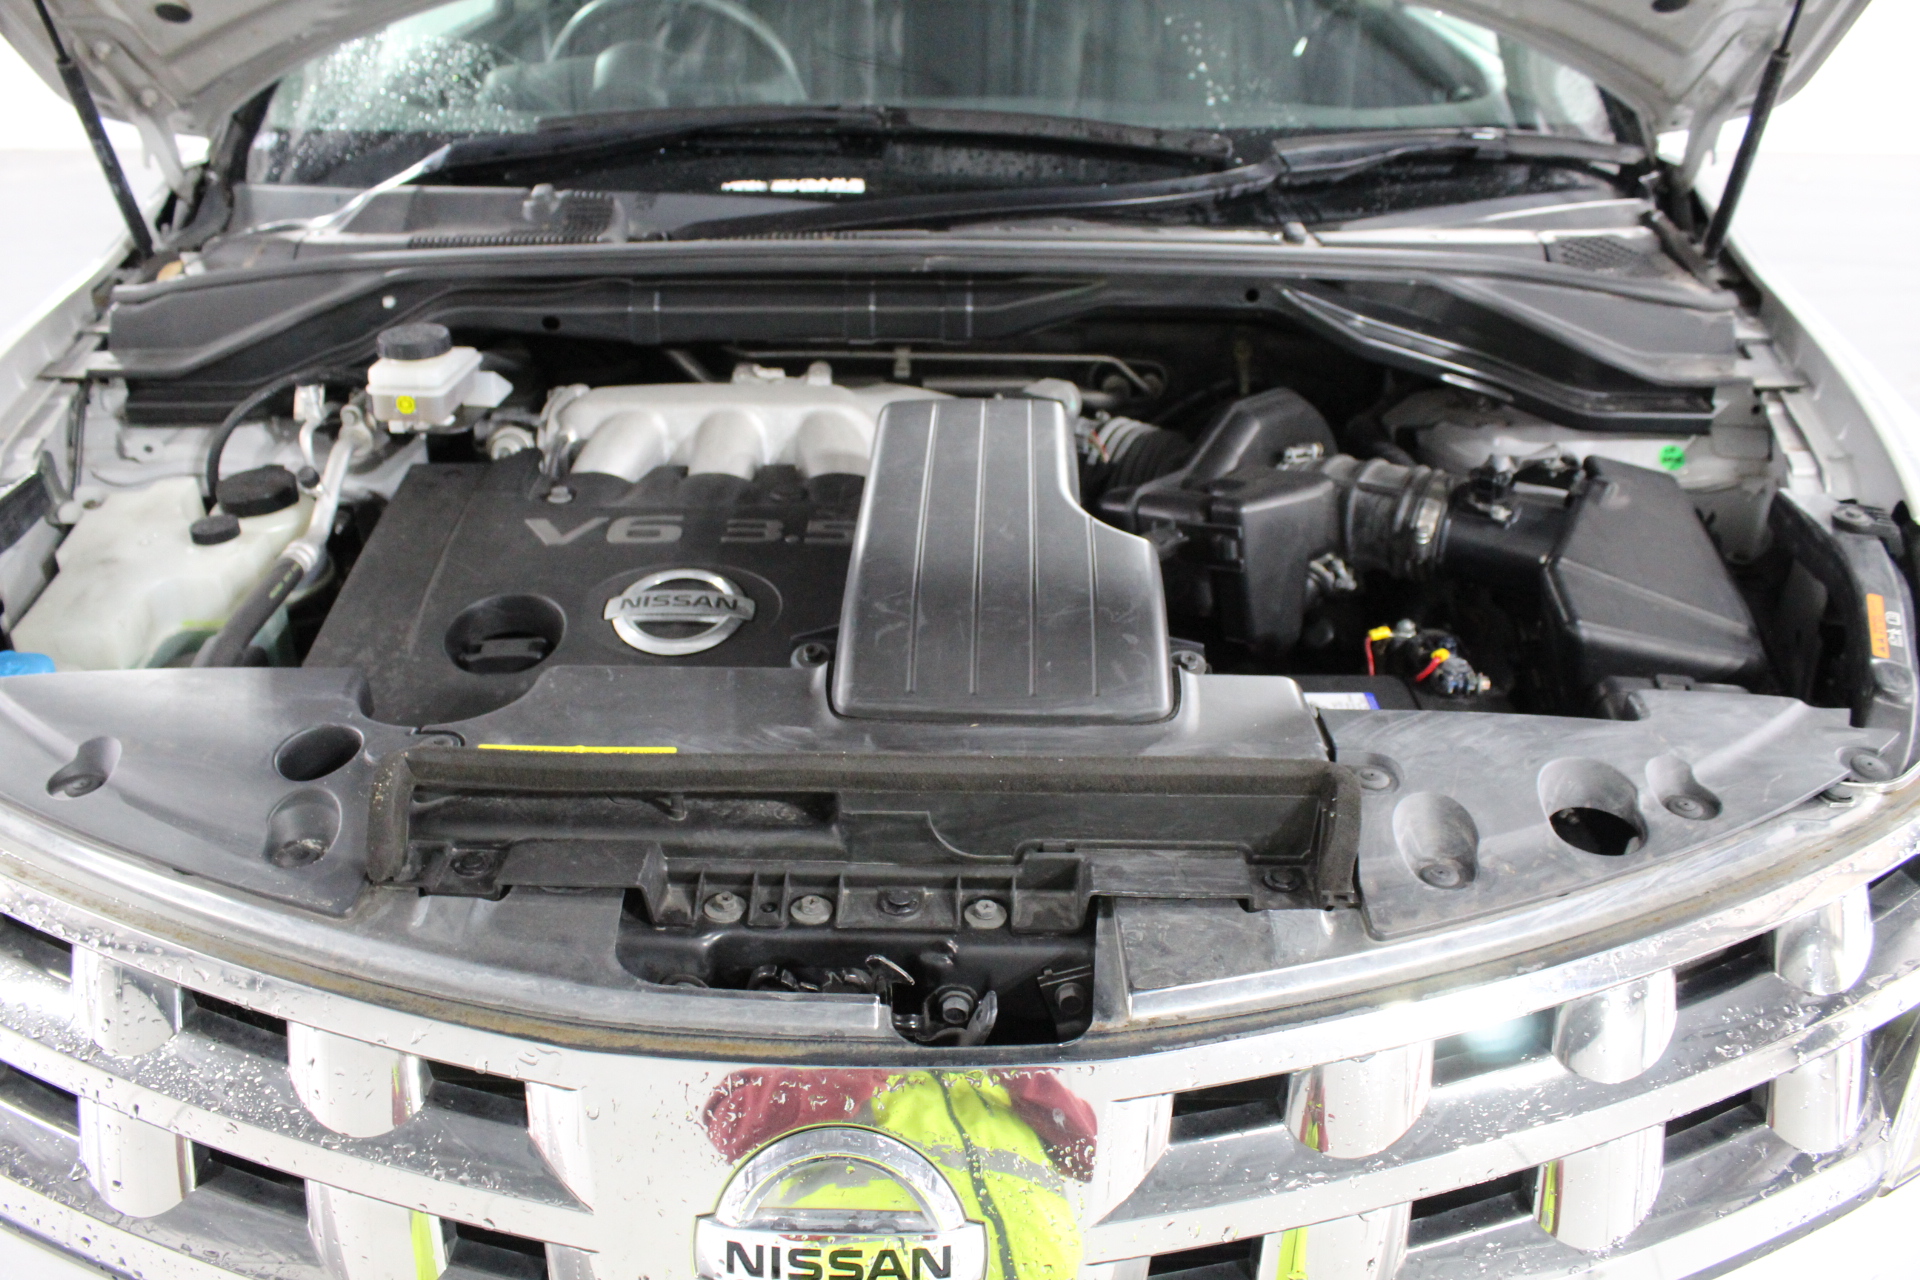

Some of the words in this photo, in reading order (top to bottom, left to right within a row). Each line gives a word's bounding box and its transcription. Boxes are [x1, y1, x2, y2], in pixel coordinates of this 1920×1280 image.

[524, 515, 684, 546] V6
[720, 518, 857, 544] 3.5
[620, 595, 738, 610] NISSAN
[726, 1240, 951, 1280] NISSAN
